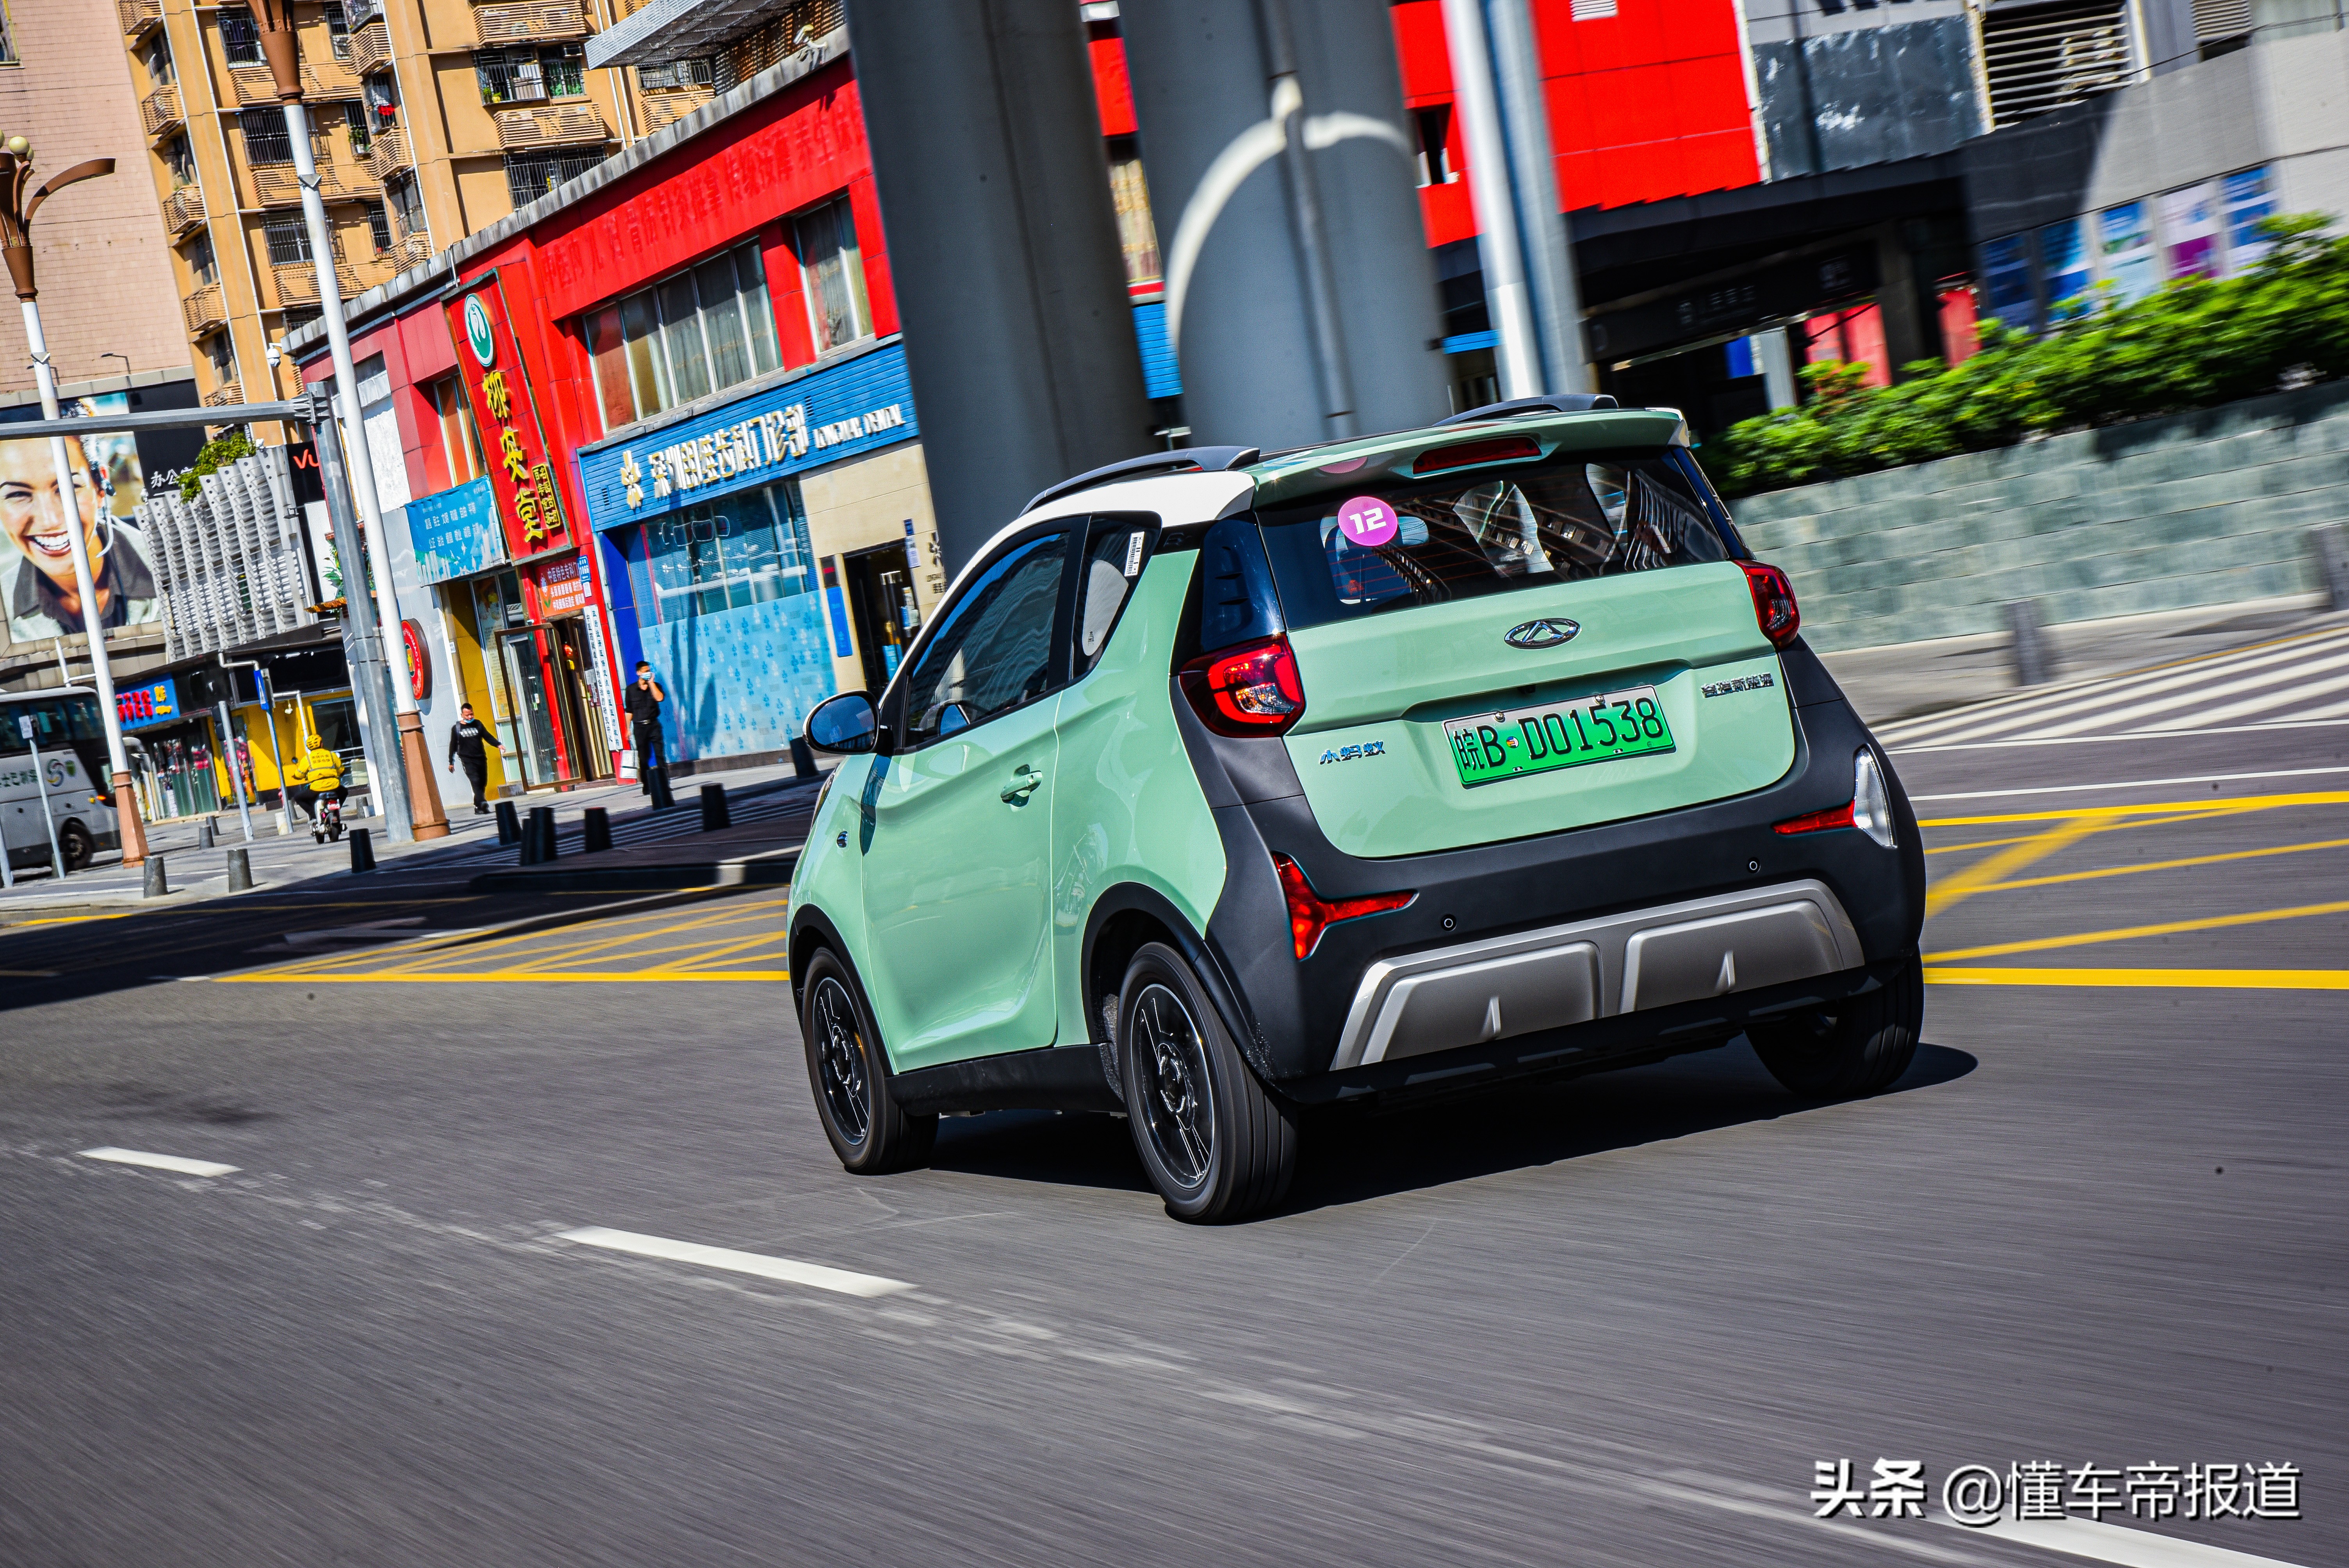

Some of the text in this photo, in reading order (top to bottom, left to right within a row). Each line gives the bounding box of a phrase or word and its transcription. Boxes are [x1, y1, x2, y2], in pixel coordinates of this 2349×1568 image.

[151, 467, 194, 488] 办公
[1348, 507, 1387, 535] 12
[547, 562, 579, 584] 中医特色专科门
[1701, 672, 1775, 698] 奇瑞新能源
[1319, 740, 1386, 765] 小蚂蚁
